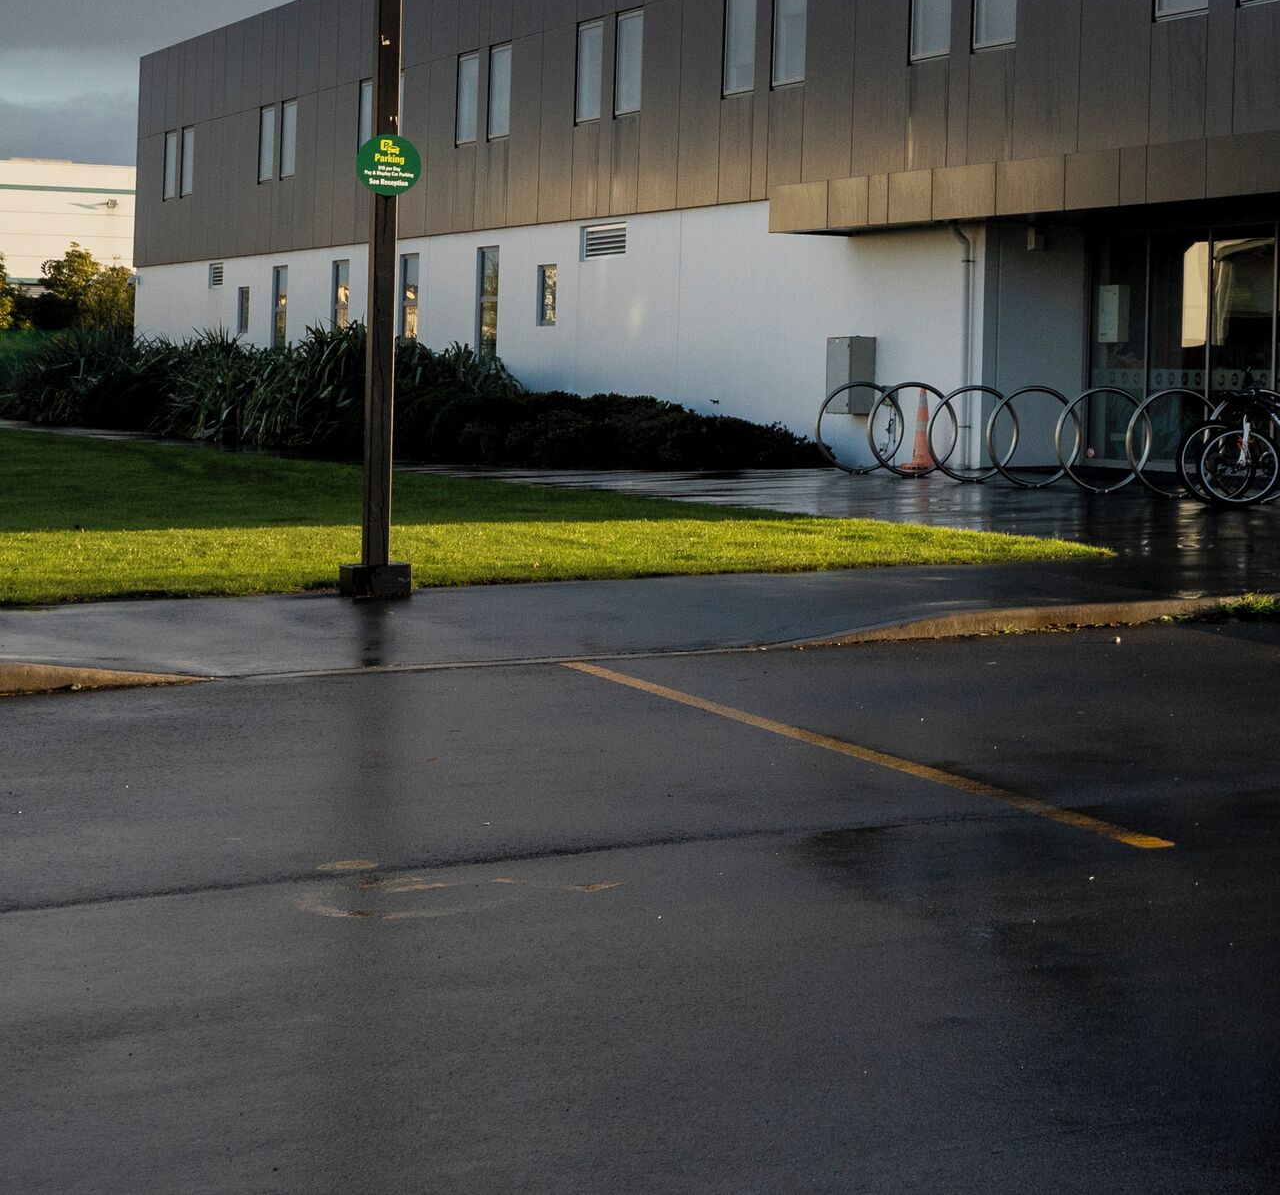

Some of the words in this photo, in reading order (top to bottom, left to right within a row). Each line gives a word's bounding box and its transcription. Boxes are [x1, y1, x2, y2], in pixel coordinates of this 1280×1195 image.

[374, 153, 405, 165] Parking
[369, 177, 380, 185] See
[380, 178, 409, 187] Reception
